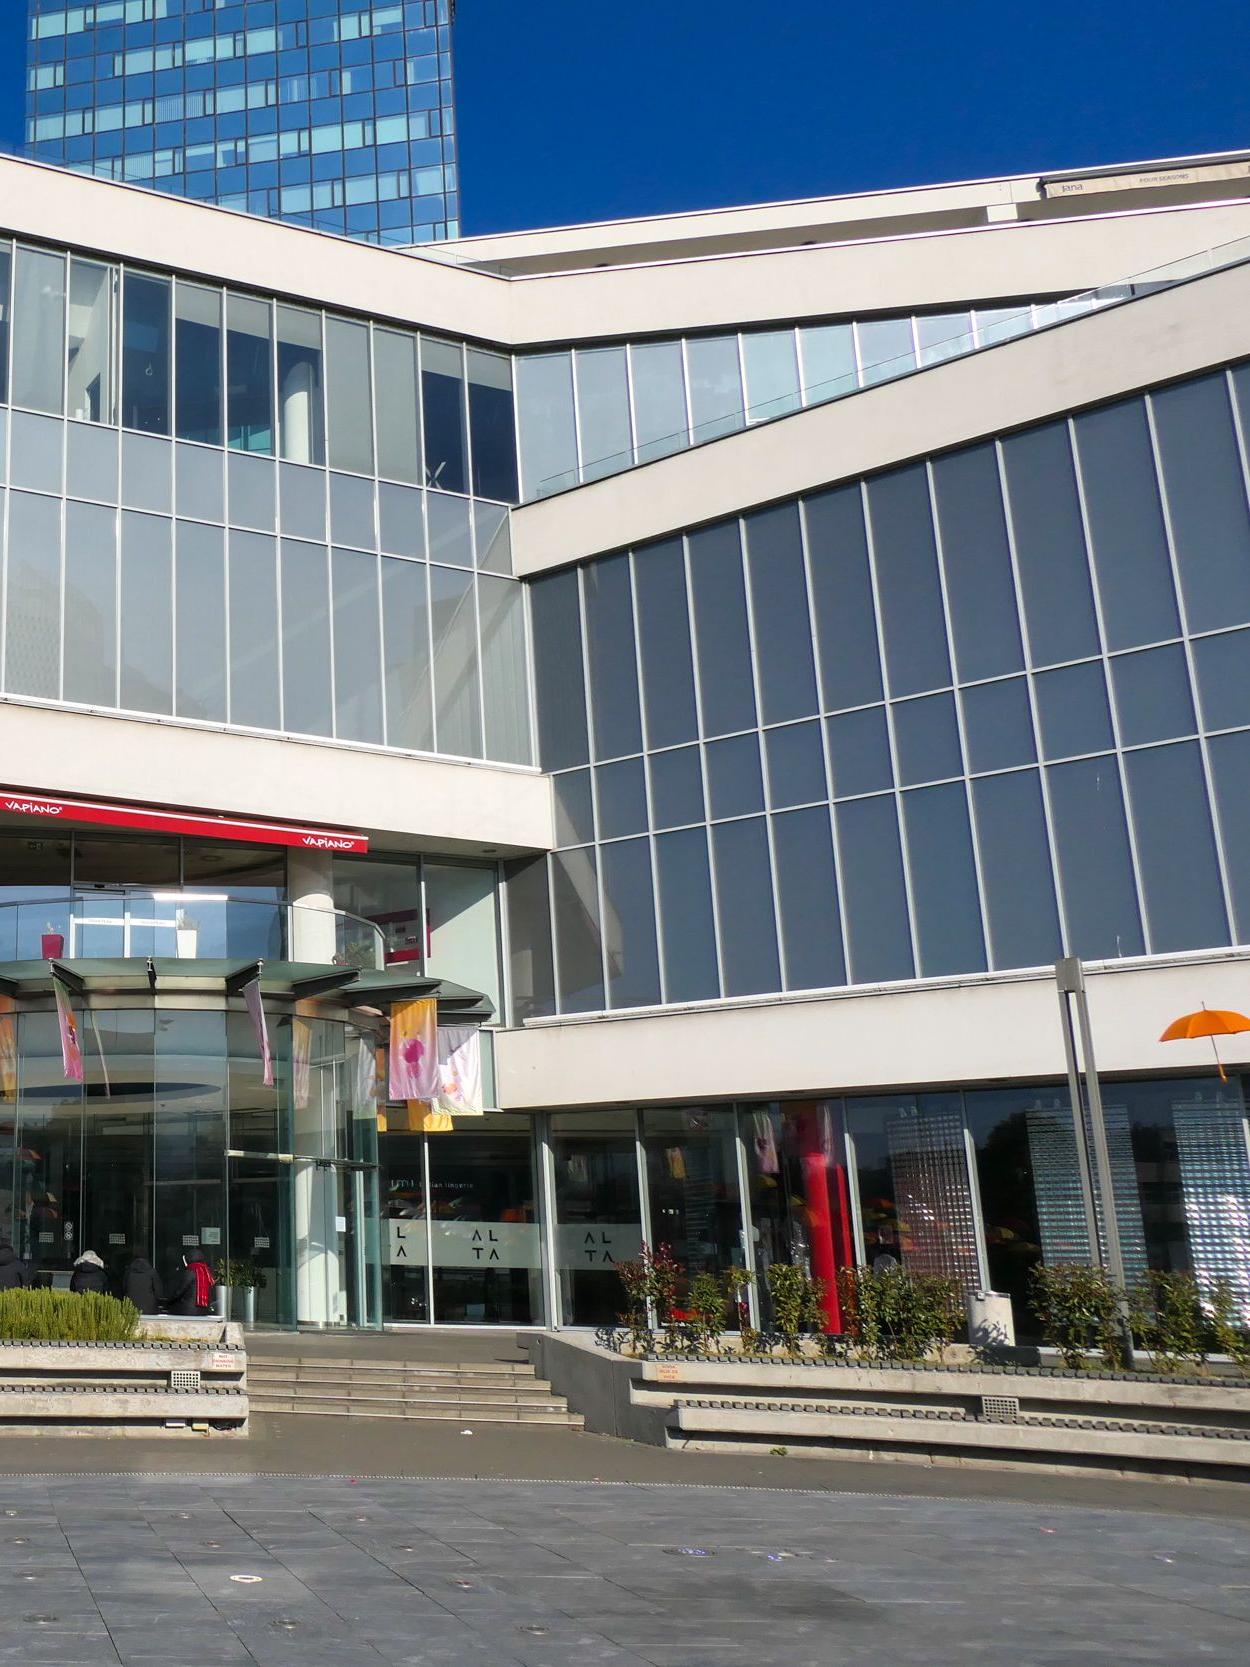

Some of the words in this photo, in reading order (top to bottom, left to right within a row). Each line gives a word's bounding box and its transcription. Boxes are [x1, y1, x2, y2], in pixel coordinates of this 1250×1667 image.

[1139, 176, 1158, 184] FOUR
[1158, 173, 1189, 182] SEASONS
[1062, 183, 1083, 193] Jana
